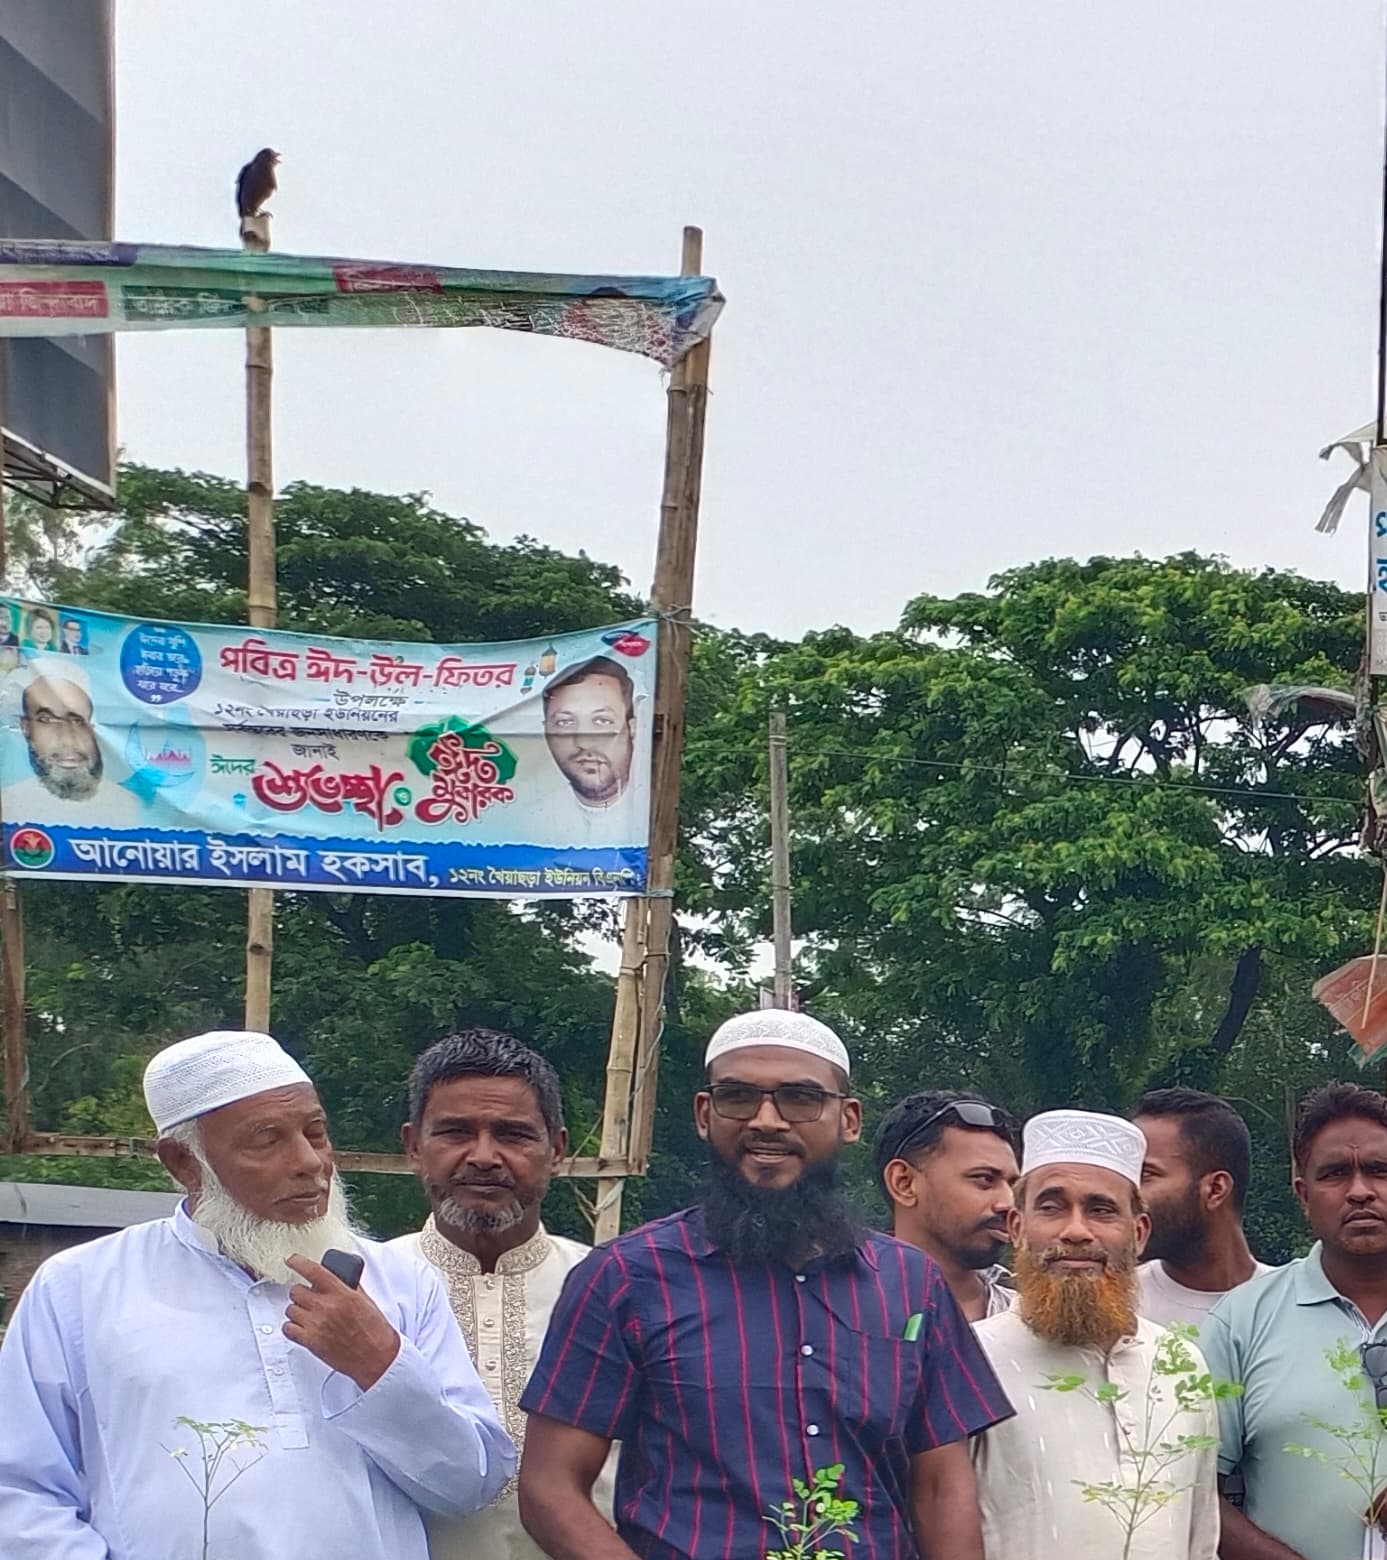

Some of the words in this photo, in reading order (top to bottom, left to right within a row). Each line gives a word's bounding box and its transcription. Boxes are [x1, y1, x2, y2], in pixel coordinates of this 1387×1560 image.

[219, 638, 300, 681] পবিত্র
[333, 689, 409, 708] উপলক্ষে
[290, 743, 340, 761] জানাই
[210, 754, 256, 776] ঈদের
[67, 836, 200, 872] আনোয়ার
[205, 836, 310, 877] ইসলাম
[317, 849, 439, 888] হকসাব,
[449, 867, 485, 886] ১২নং
[544, 866, 591, 887] ইউনিয়ন
